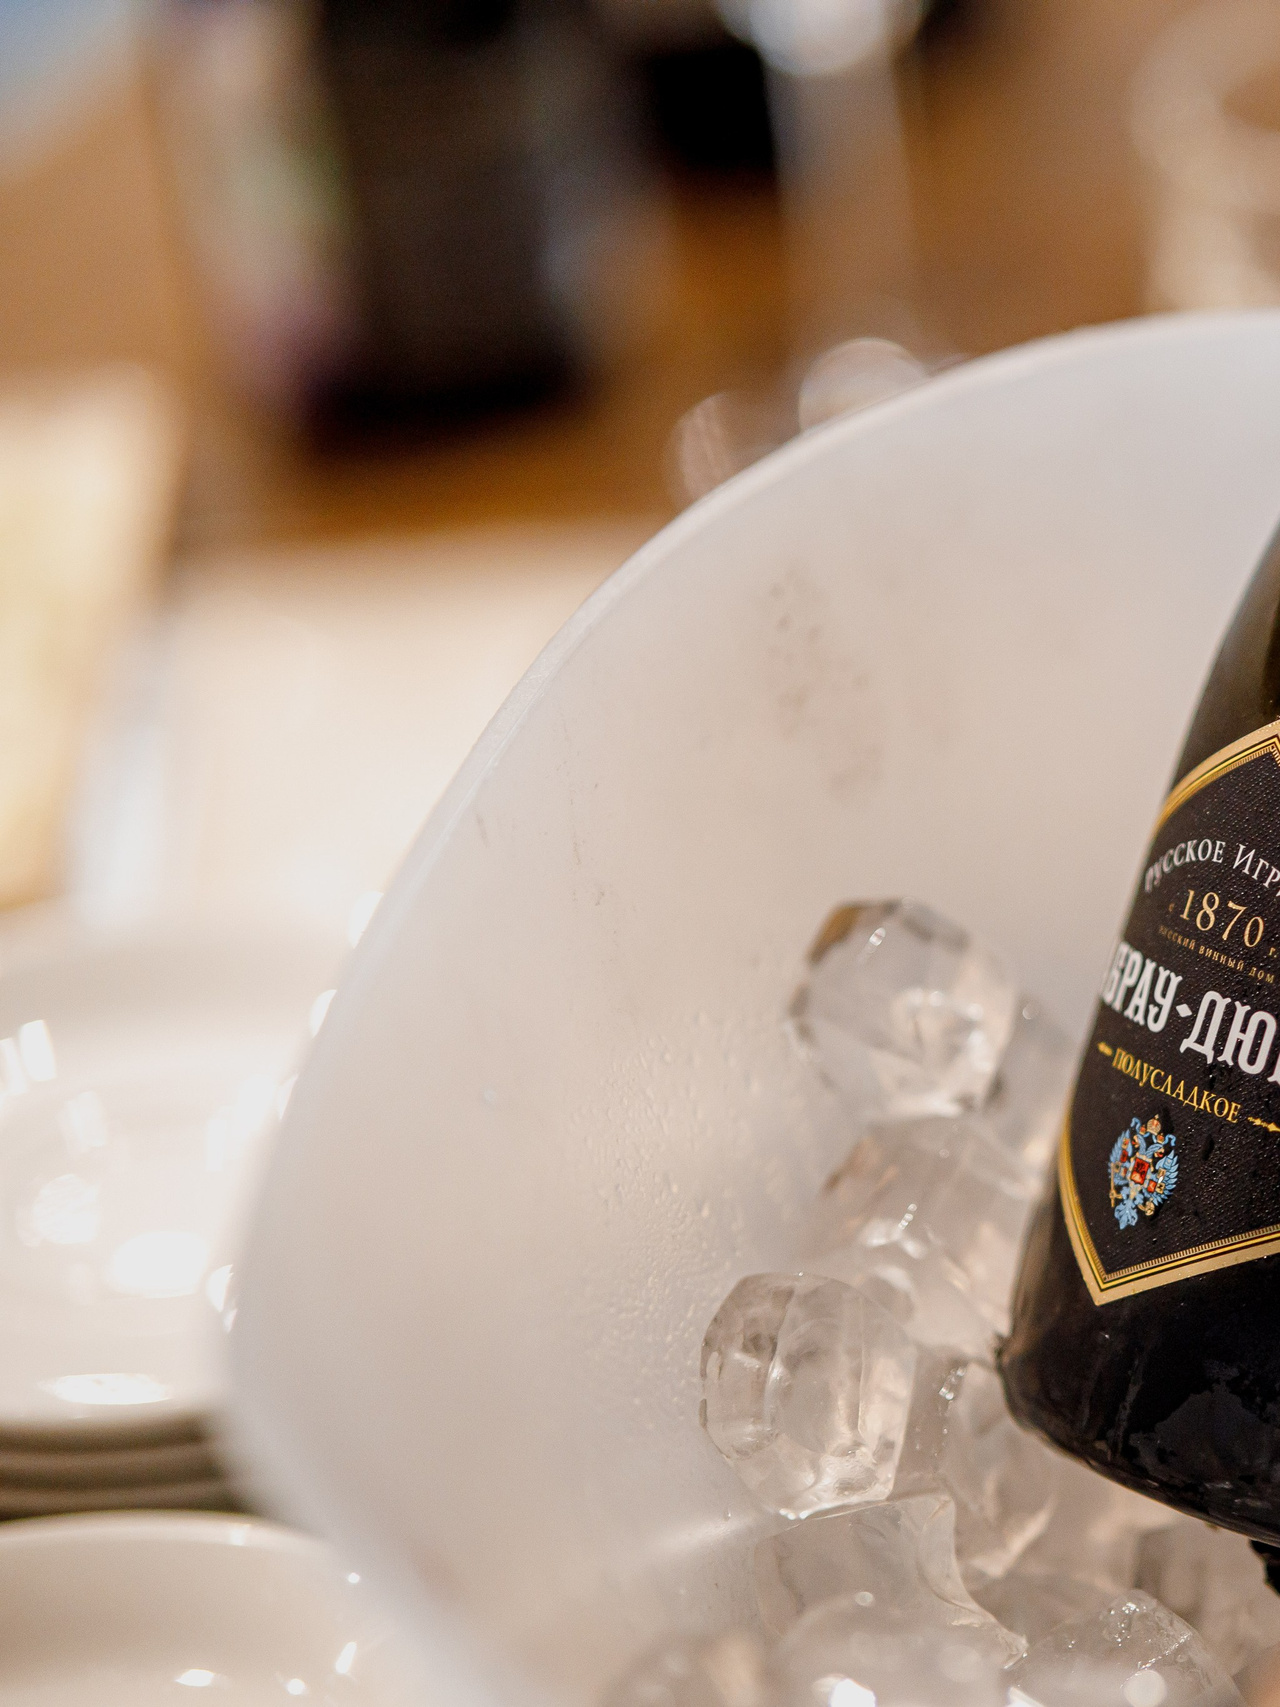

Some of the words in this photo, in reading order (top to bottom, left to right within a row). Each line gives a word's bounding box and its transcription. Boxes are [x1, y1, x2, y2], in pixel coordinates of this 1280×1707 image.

[1144, 838, 1226, 893] РУССКОЕ
[1180, 889, 1265, 948] 1870
[1111, 1047, 1242, 1124] ПОЛУСЛАДКОЕ
